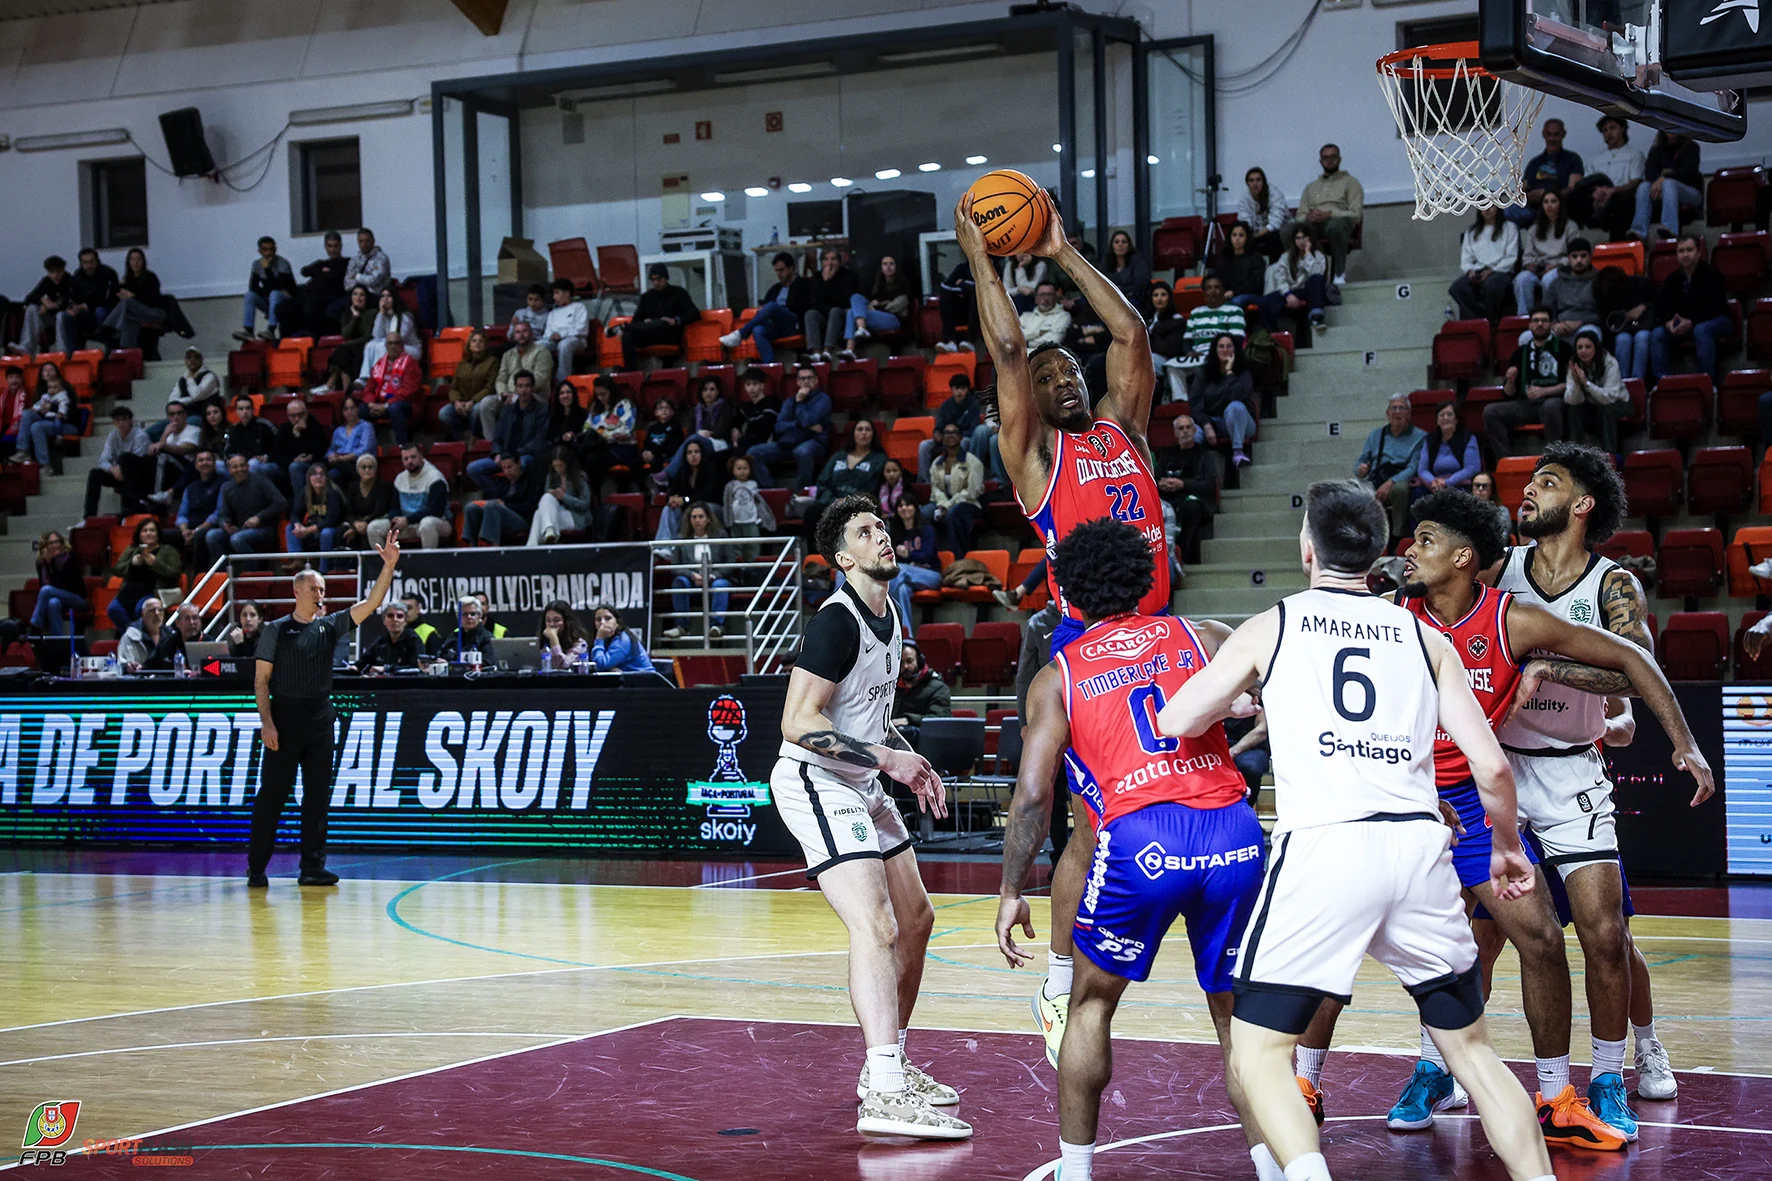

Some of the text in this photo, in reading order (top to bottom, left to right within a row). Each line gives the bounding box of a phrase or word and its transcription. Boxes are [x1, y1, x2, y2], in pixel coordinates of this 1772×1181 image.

[972, 205, 1008, 226] lson
[1398, 286, 1410, 298] G
[1365, 352, 1375, 365] F
[1329, 423, 1340, 435] E
[1105, 482, 1146, 522] 22
[1292, 495, 1303, 508] D
[1252, 571, 1264, 585] C
[1301, 615, 1403, 643] AMARANTE
[1177, 649, 1195, 669] JR
[1332, 647, 1376, 722] 6
[1318, 731, 1412, 765] Santiago
[1370, 732, 1411, 743] QUEIJOS
[32, 712, 107, 806] DE
[111, 712, 403, 808] PORTAL
[416, 710, 616, 809] SKOIY
[833, 806, 867, 816] FIDELI
[700, 819, 757, 846] skoiy
[1164, 845, 1260, 871] SUTAFER
[1098, 927, 1145, 950] GRUPO
[1096, 939, 1143, 962] PS
